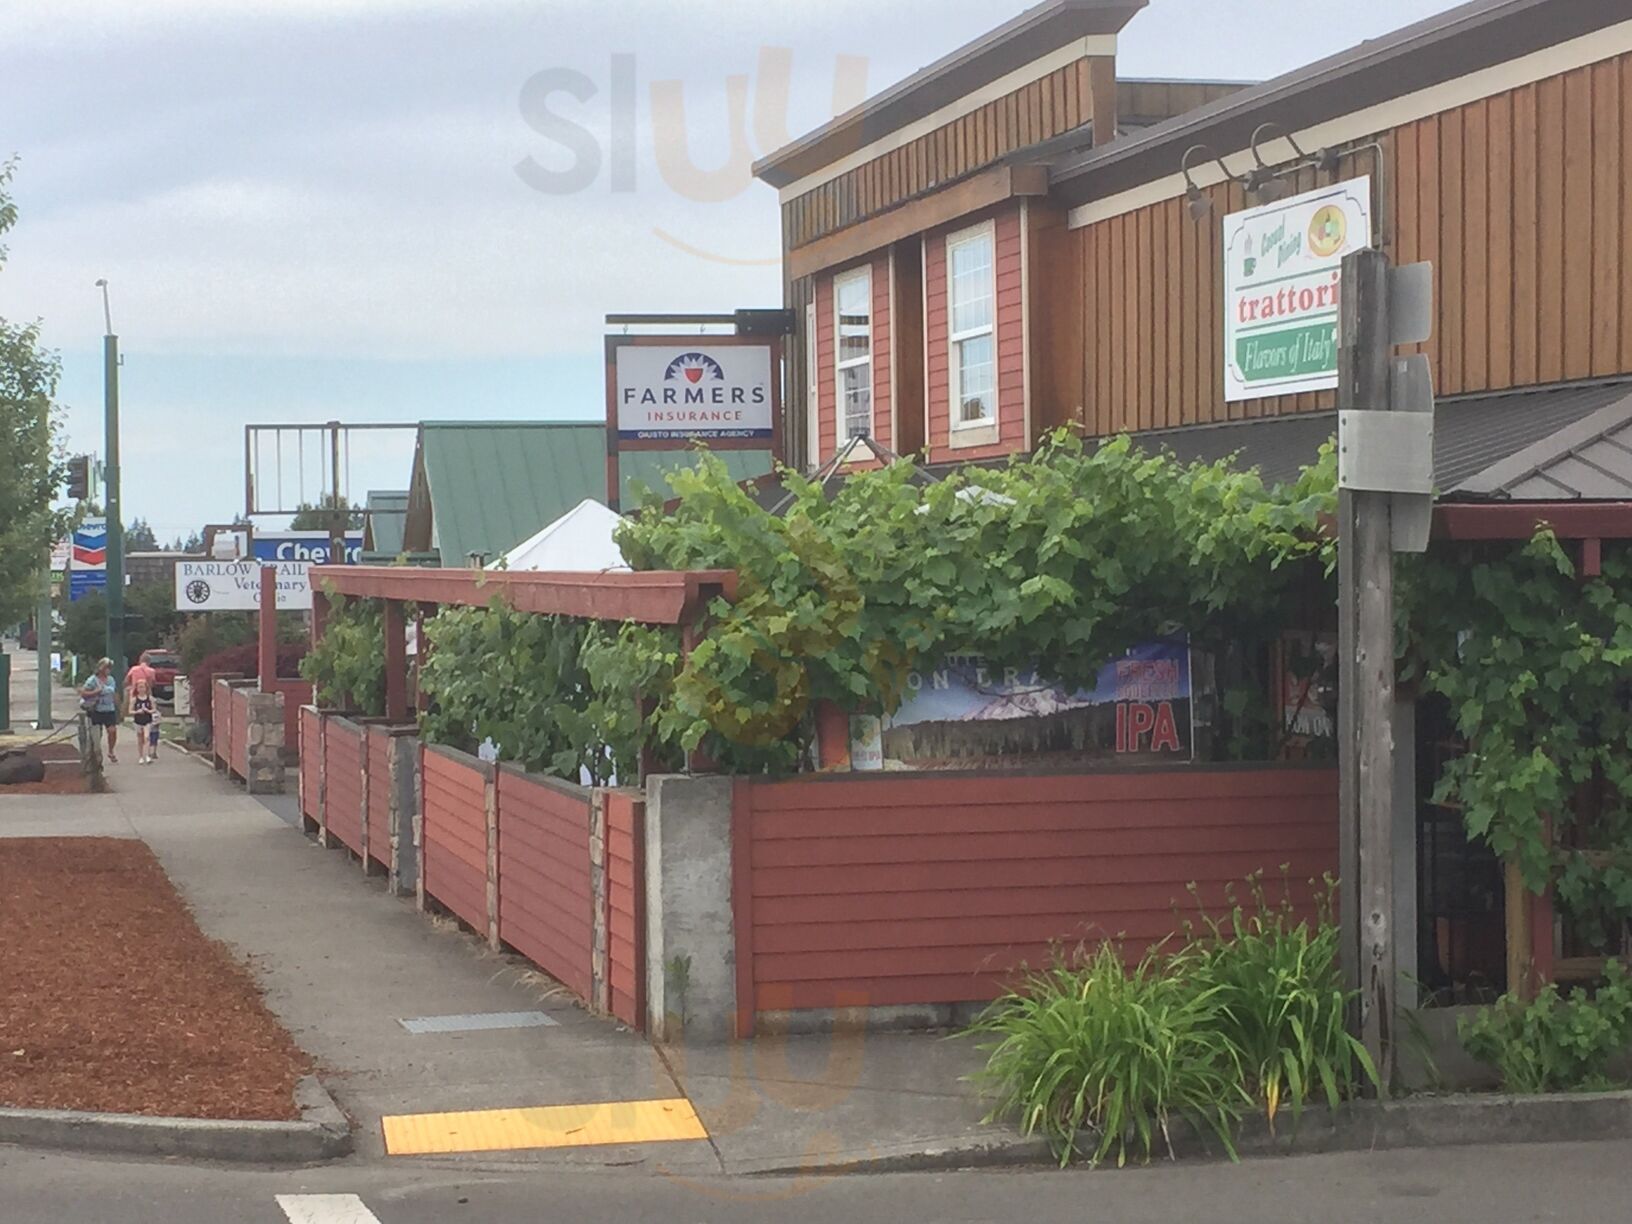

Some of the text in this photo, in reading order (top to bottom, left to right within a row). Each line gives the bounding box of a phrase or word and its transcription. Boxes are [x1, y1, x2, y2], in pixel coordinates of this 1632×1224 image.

[1239, 271, 1338, 322] trattori
[1288, 333, 1302, 373] of
[1302, 329, 1331, 370] Italy
[623, 386, 764, 404] FARMERS
[647, 411, 742, 421] INSURANCE
[719, 430, 754, 438] AGENCY
[184, 563, 252, 576] BARLOW
[906, 669, 949, 691] ON
[1115, 702, 1181, 752] IPA
